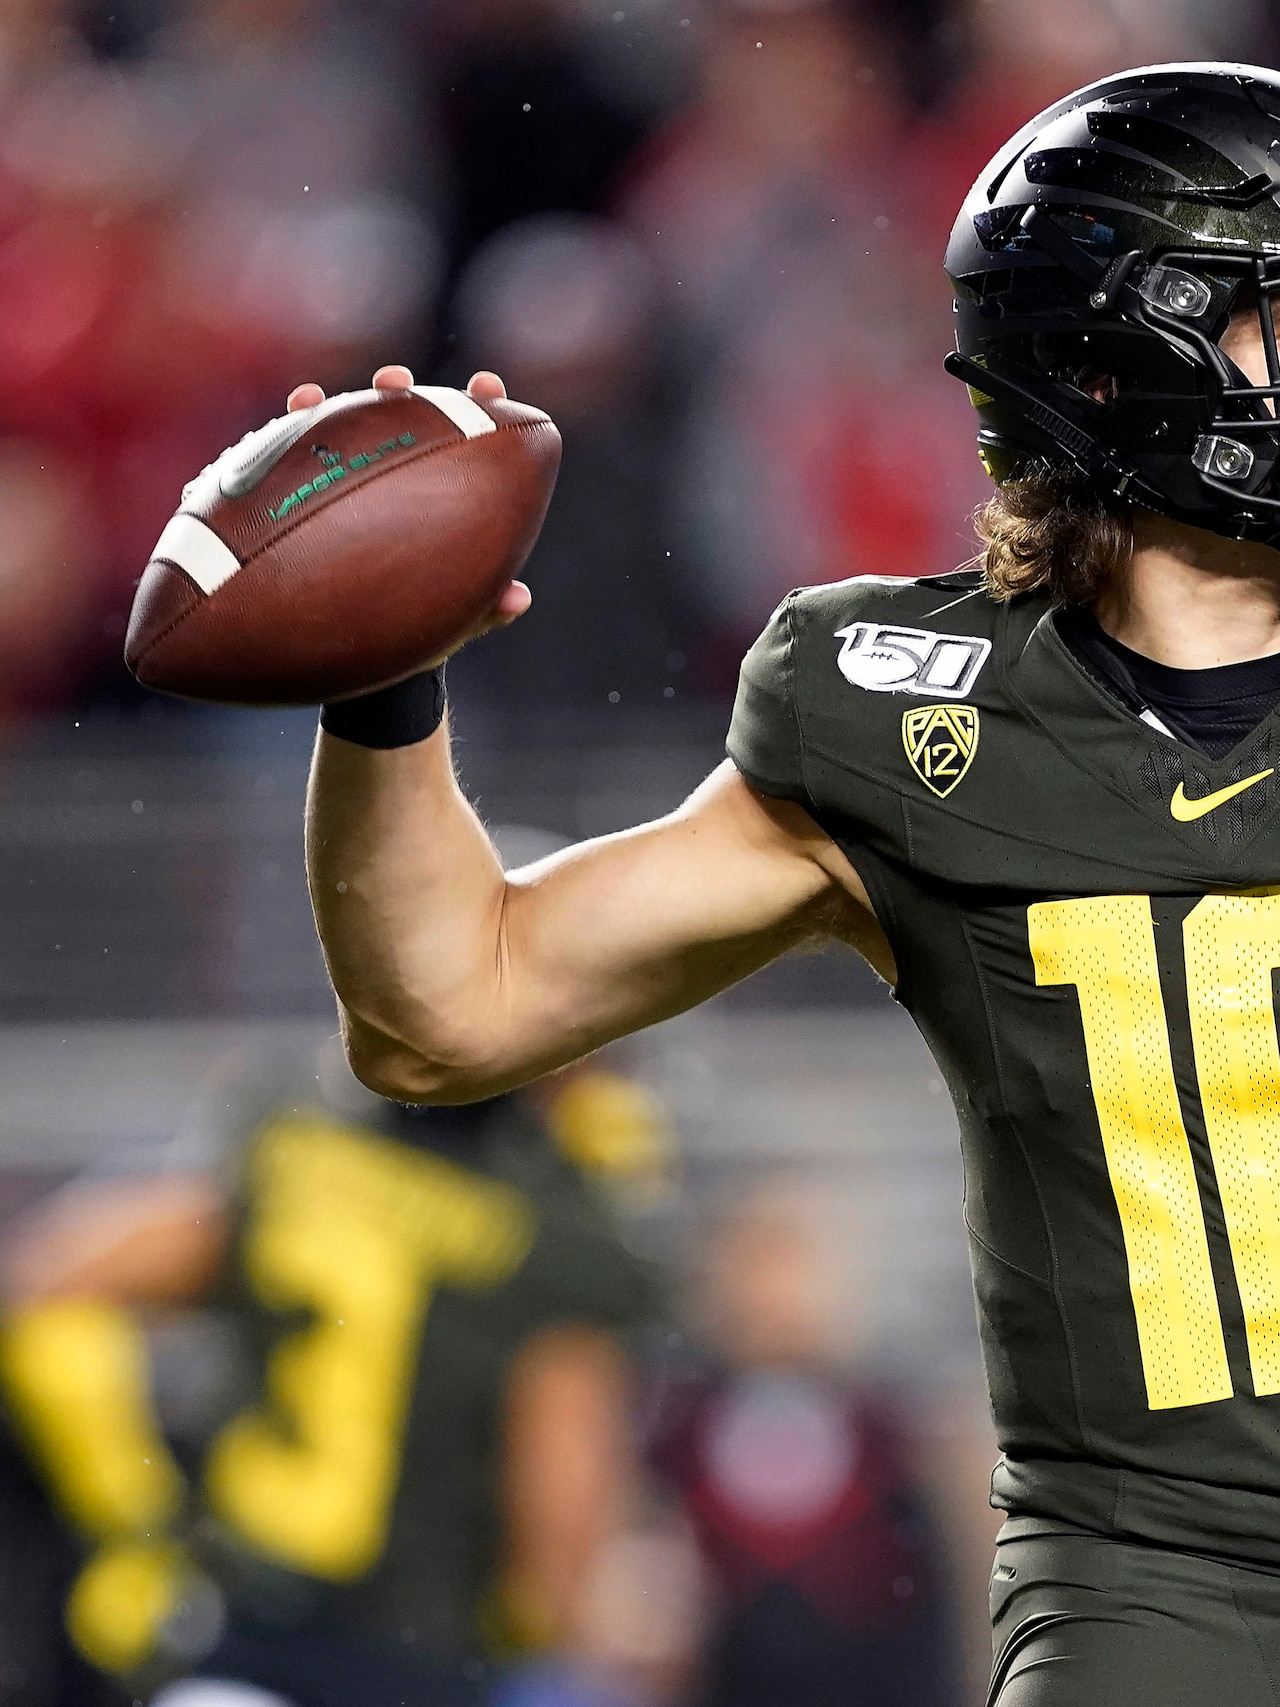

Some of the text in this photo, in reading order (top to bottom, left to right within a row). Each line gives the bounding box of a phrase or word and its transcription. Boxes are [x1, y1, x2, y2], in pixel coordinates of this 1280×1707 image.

[834, 622, 992, 698] 150
[906, 708, 973, 762] PAC
[923, 743, 960, 778] 12
